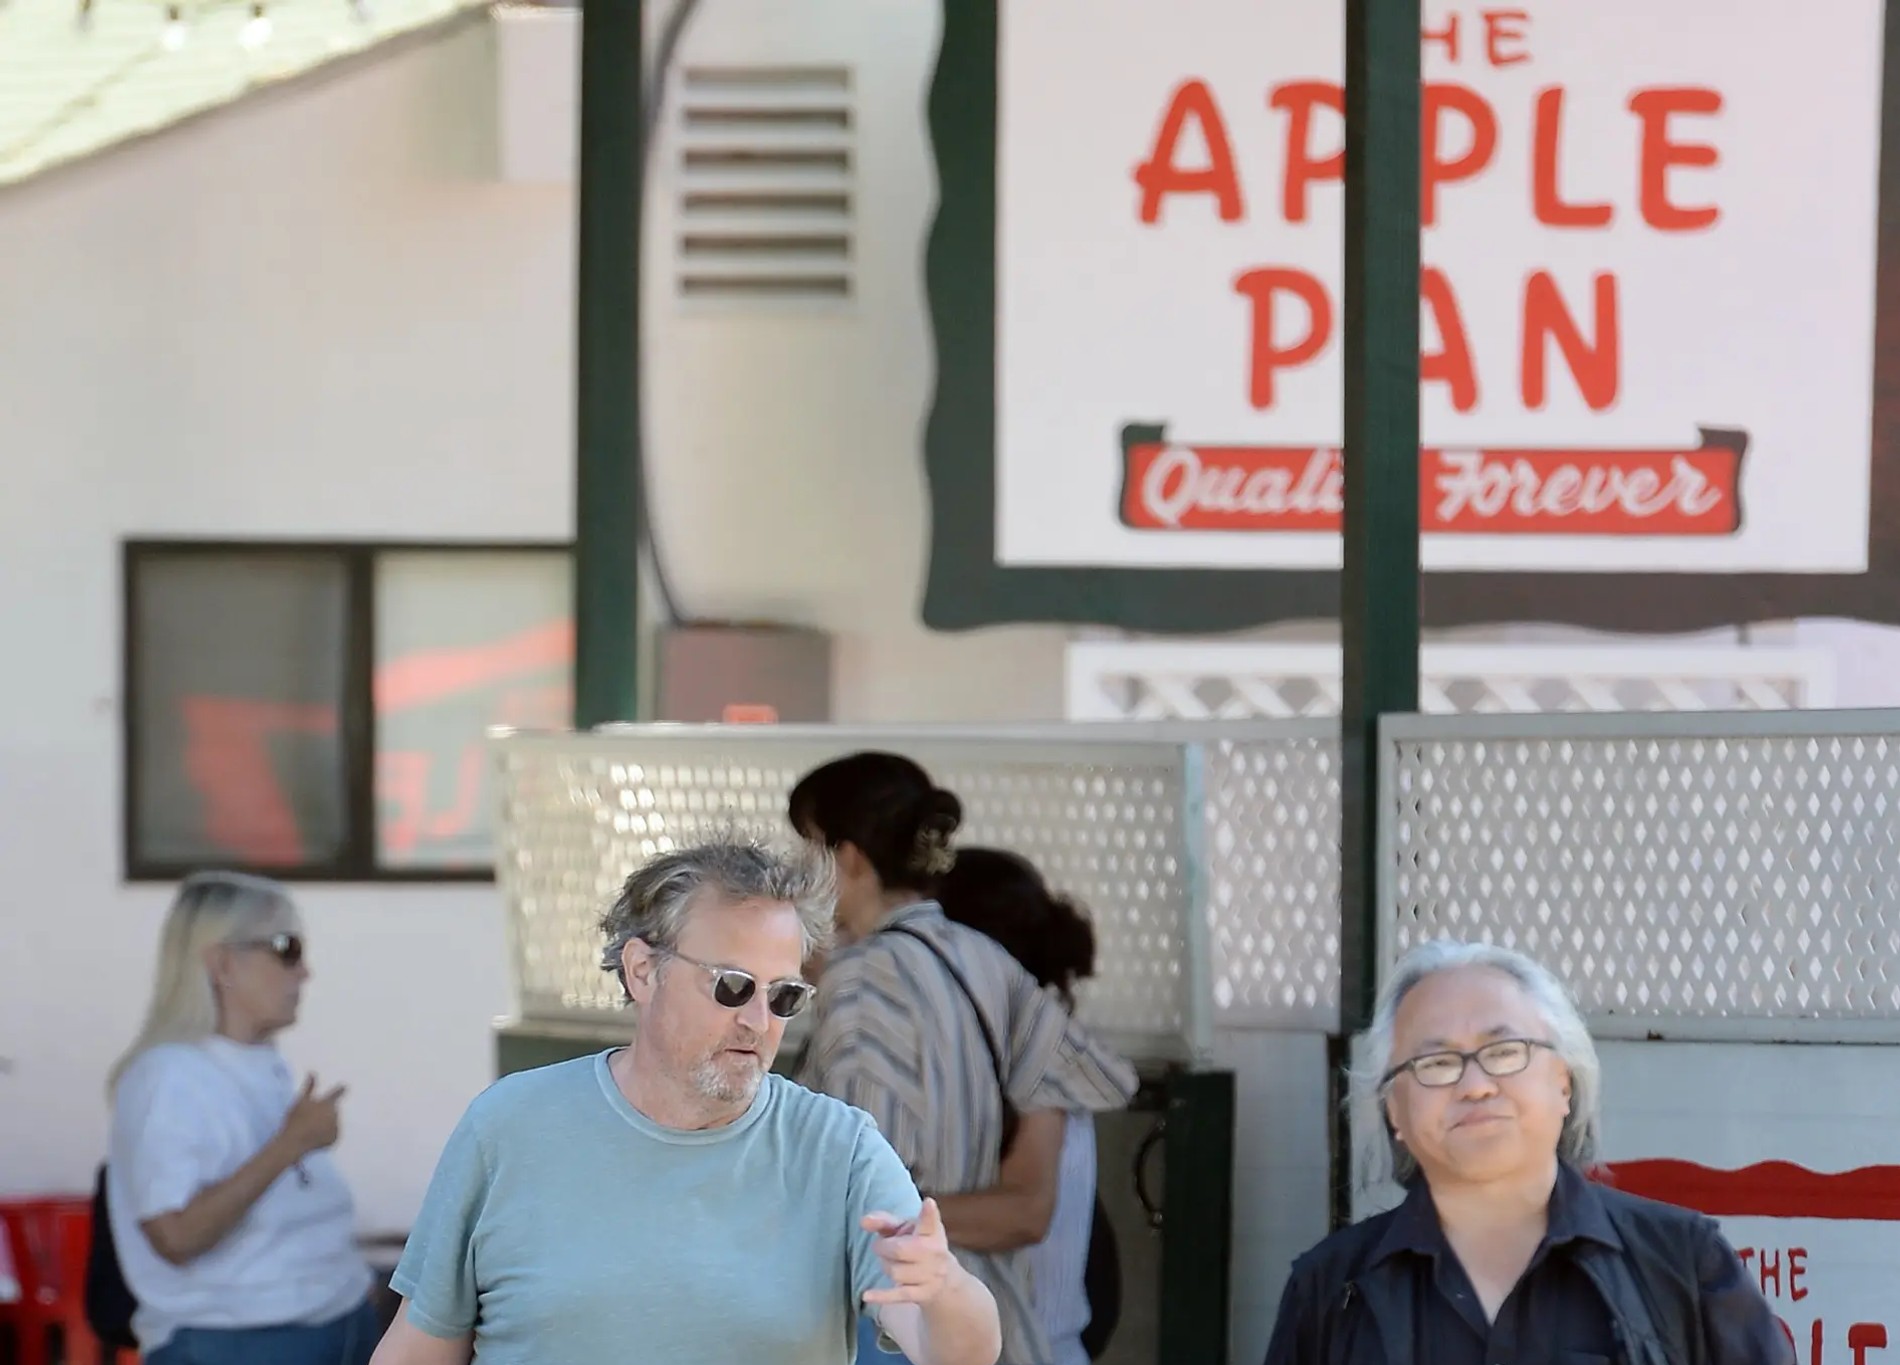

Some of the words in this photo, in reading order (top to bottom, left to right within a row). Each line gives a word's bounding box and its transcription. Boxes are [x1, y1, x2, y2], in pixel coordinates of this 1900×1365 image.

[1421, 10, 1530, 66] HE
[1133, 76, 1723, 230] APPLE
[1142, 449, 1343, 528] Quali
[1436, 450, 1721, 522] Forever
